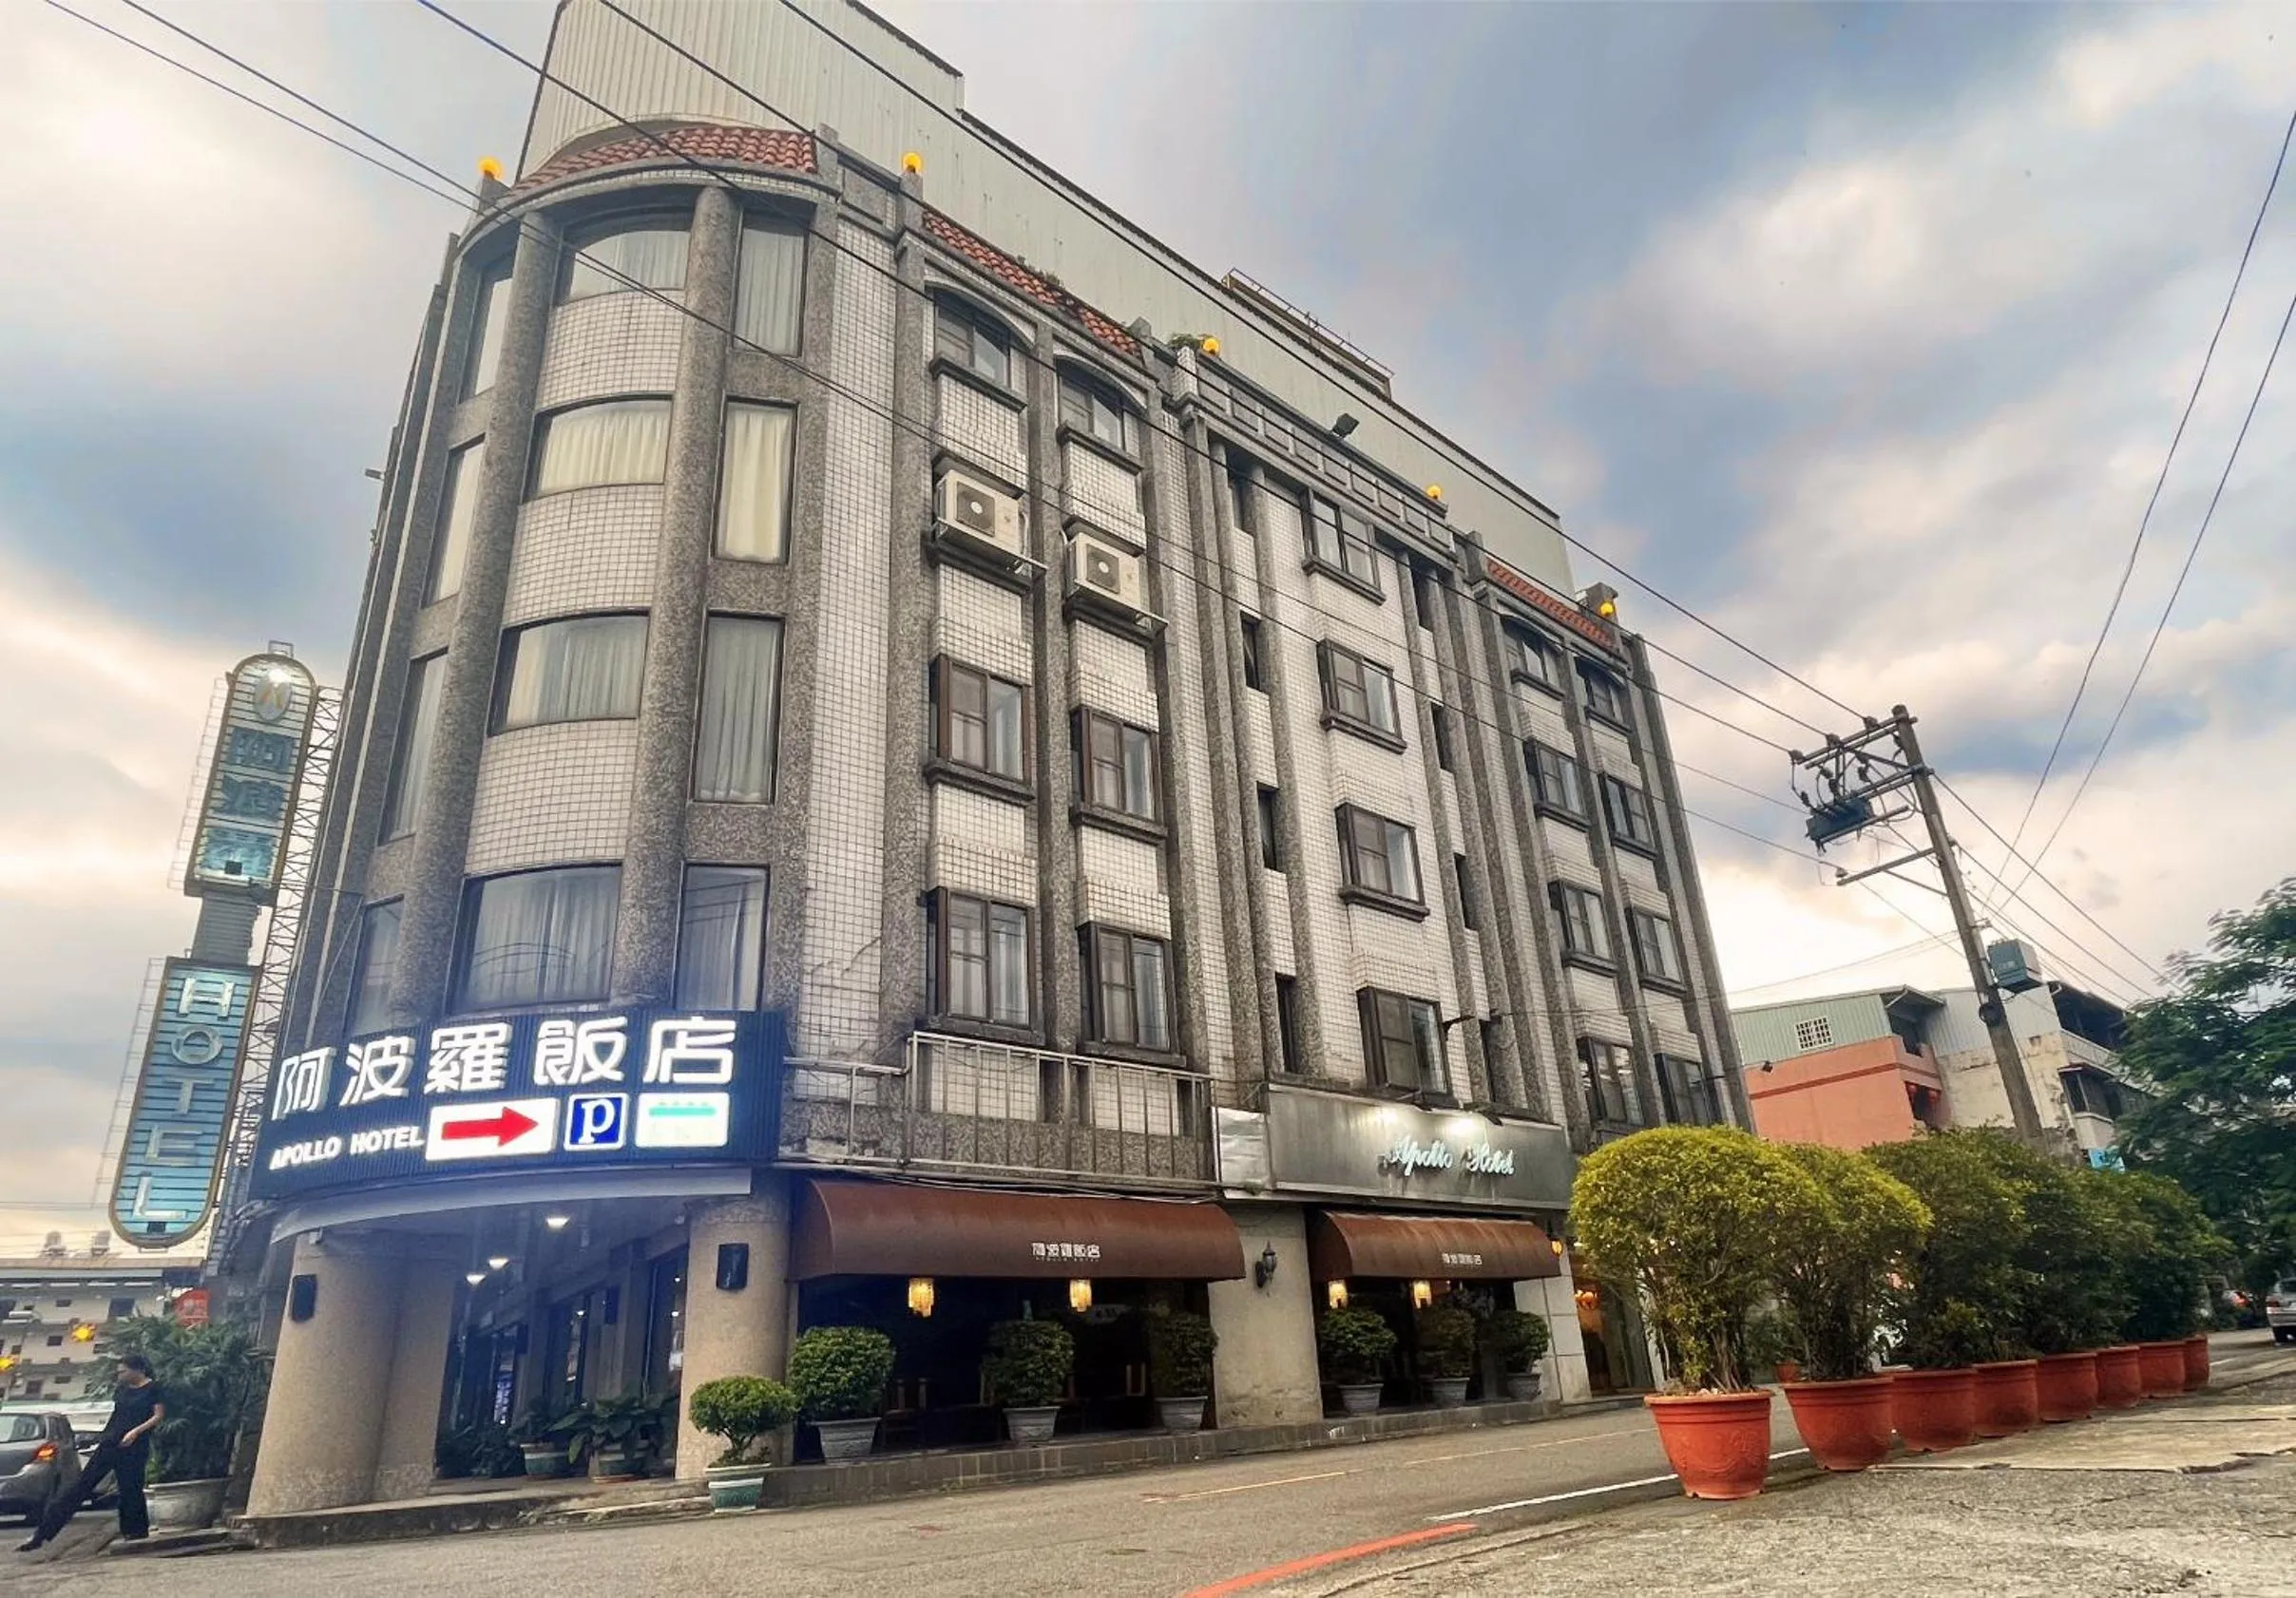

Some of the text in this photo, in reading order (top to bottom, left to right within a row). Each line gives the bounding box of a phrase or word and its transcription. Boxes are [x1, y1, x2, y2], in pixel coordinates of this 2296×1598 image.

[272, 1016, 737, 1120] 阿波羅飯店
[132, 976, 236, 1222] HOTEL
[579, 1097, 617, 1145] P
[269, 1125, 426, 1170] APOLLO HOTEL
[1465, 1143, 1515, 1175] Hotel
